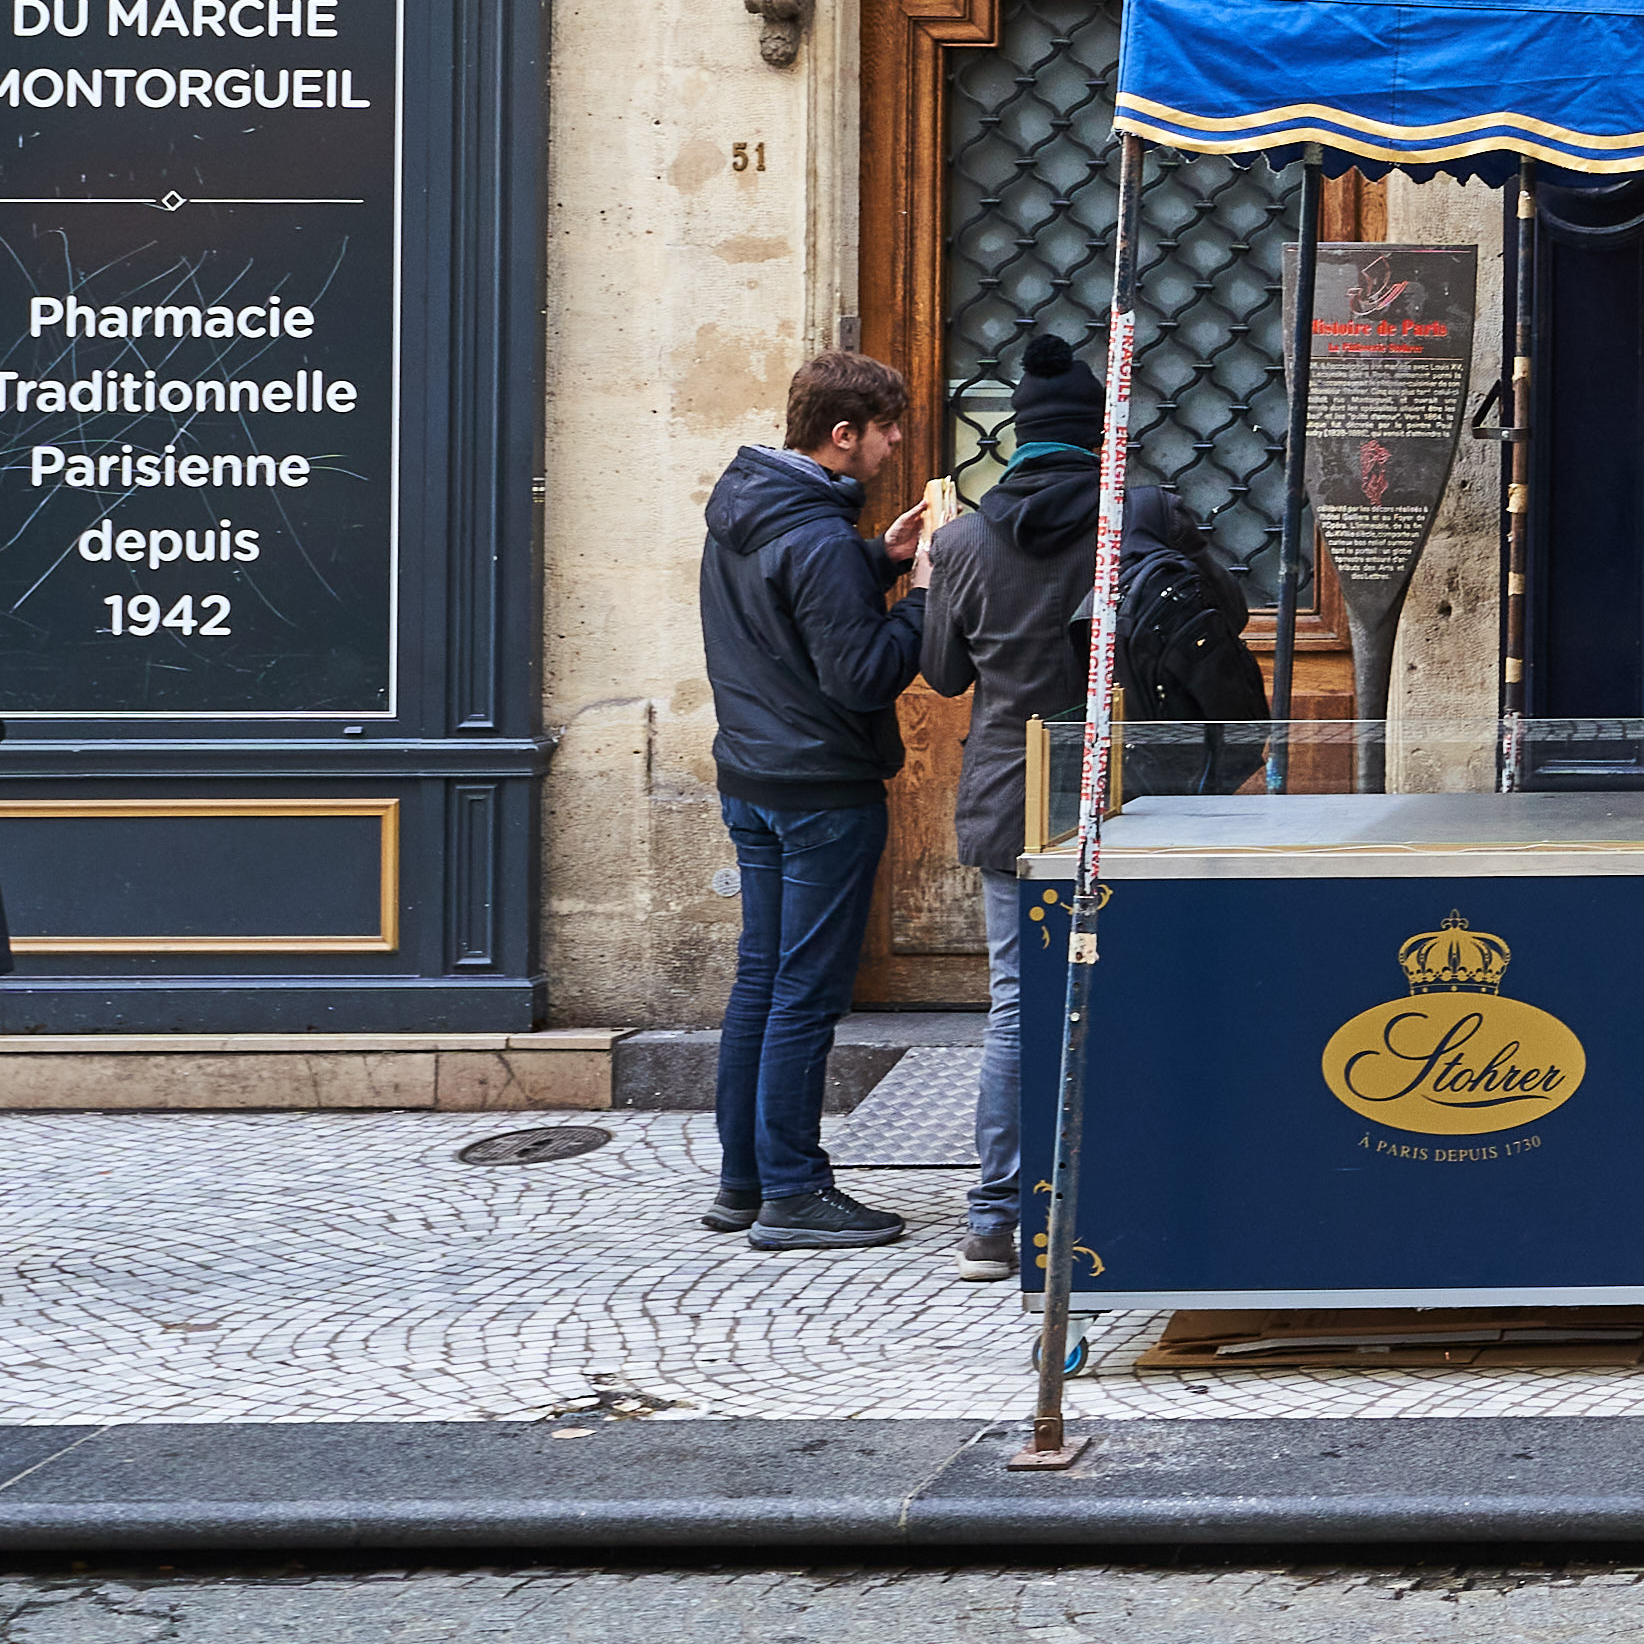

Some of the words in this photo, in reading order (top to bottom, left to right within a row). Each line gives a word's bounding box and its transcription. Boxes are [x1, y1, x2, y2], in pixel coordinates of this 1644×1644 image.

[732, 142, 767, 173] 51
[30, 297, 315, 339] Pharmacie
[1377, 319, 1398, 336] de
[30, 444, 311, 488] Parisienne
[79, 519, 260, 567] depuis
[103, 595, 232, 636] 1942
[1344, 1011, 1566, 1107] Stohrer
[1376, 1140, 1429, 1161] PARIS
[1434, 1146, 1498, 1162] DEPUIS
[1505, 1135, 1542, 1156] 1730
